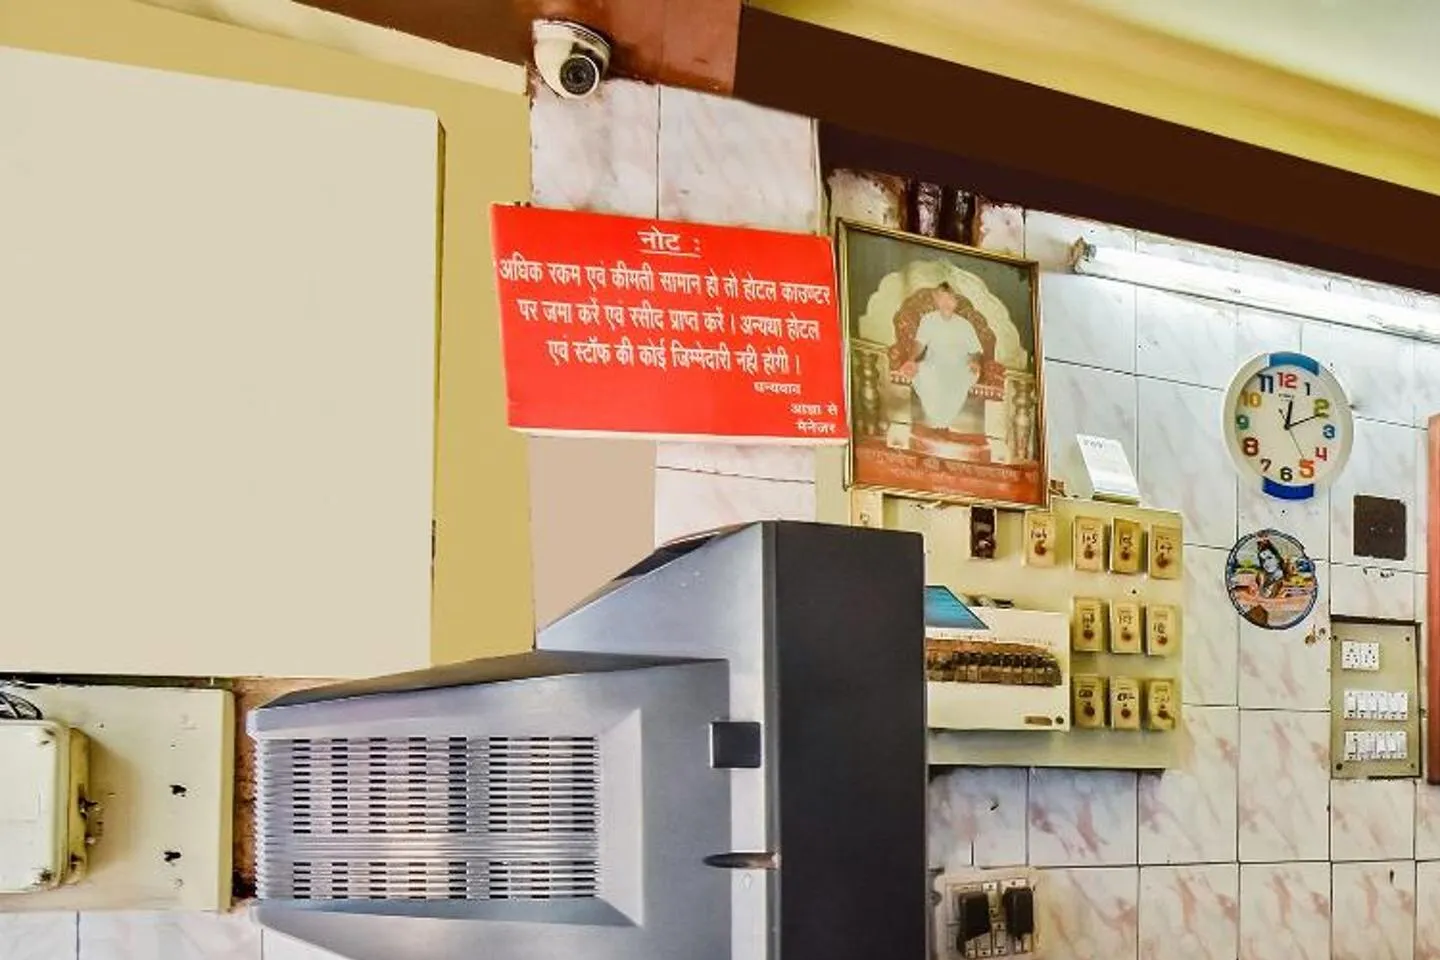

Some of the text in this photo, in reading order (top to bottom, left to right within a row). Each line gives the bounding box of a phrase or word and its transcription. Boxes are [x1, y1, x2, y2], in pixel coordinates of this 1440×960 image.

[637, 225, 681, 250] नोट
[500, 251, 543, 282] अधिक
[547, 262, 581, 285] रकम
[610, 261, 655, 292] कीमती
[658, 271, 700, 294] सामान
[704, 267, 719, 298] हो
[722, 270, 738, 299] तो
[742, 271, 777, 302] होटल
[517, 298, 538, 320] पर
[541, 301, 572, 323] जमा
[628, 300, 665, 331] रसीद
[669, 309, 700, 332] प्राप्त
[740, 315, 782, 338] अन्यथा
[785, 312, 820, 341] होटल
[614, 336, 634, 366] की
[637, 338, 667, 371] कोई
[761, 345, 788, 375] होगी
[1257, 374, 1273, 394] 11
[1277, 372, 1297, 389] 12
[1304, 382, 1311, 396] 1
[1240, 389, 1262, 408] 10
[1313, 399, 1330, 418] 2
[1236, 414, 1249, 430] 9
[1323, 424, 1335, 439] 3
[1242, 437, 1259, 456] 8
[1315, 447, 1327, 461] 4
[1260, 459, 1272, 472] 7
[1280, 466, 1293, 482] 6
[1299, 460, 1314, 478] 5
